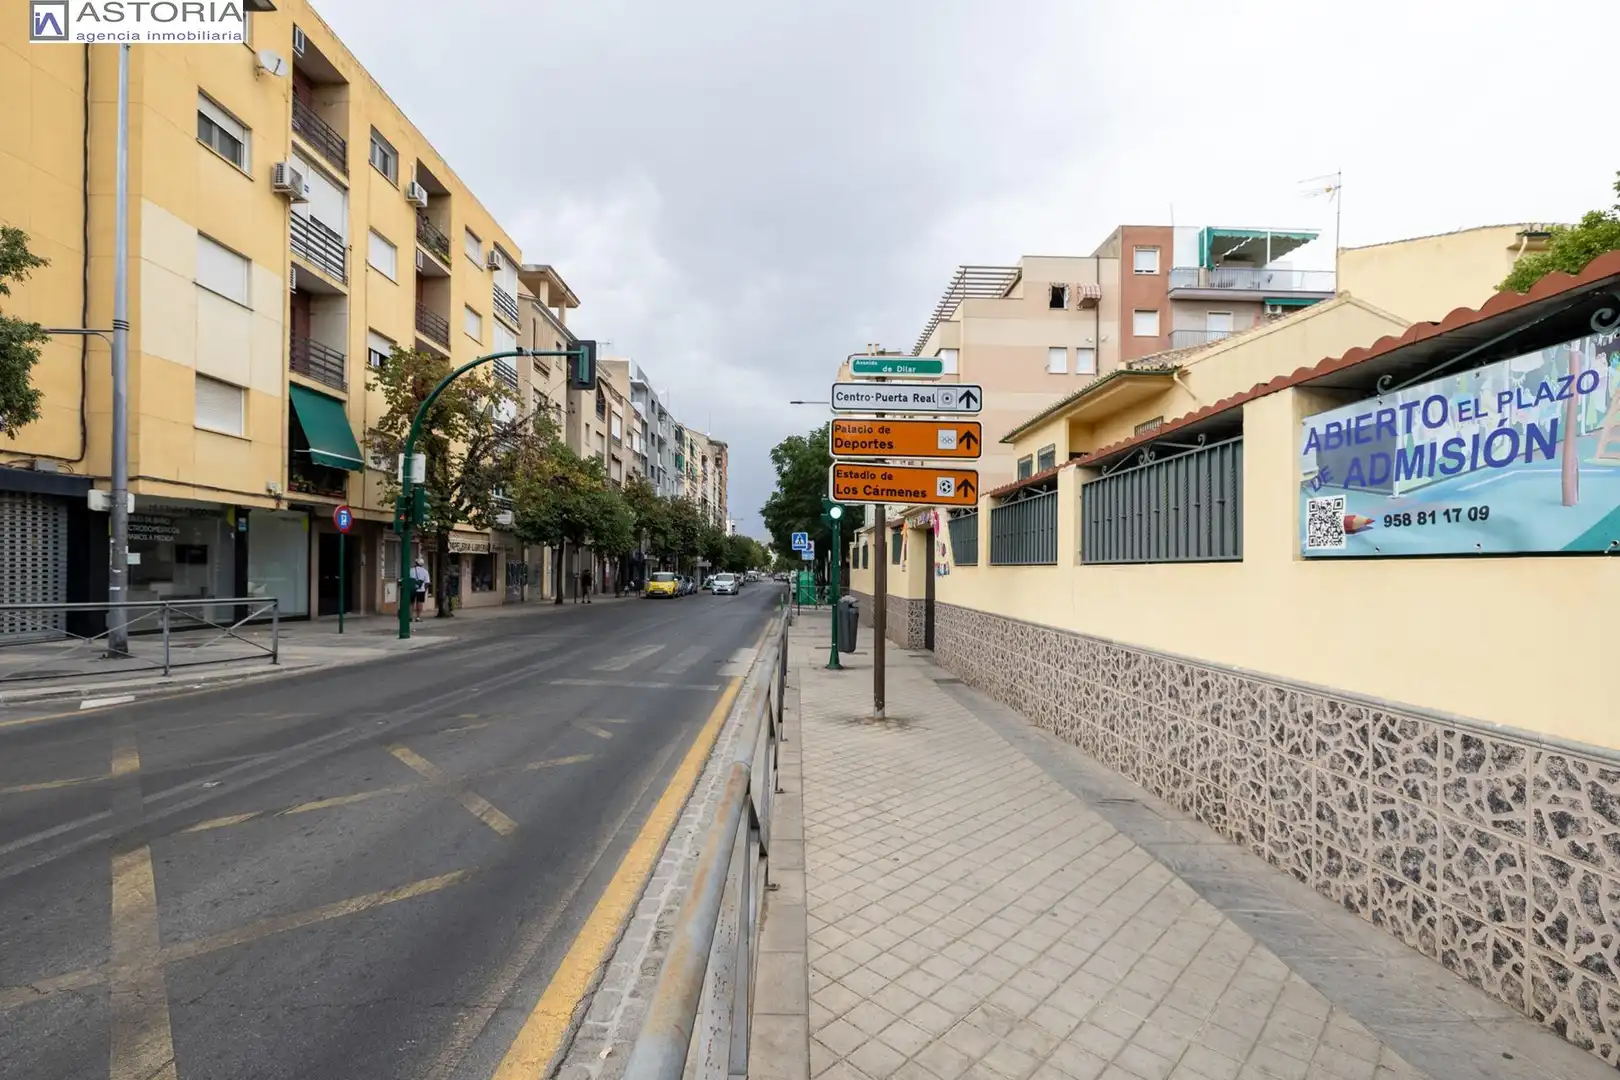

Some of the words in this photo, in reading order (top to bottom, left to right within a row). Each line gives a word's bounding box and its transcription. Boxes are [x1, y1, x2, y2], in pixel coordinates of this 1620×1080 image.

[882, 365, 892, 373] de
[913, 393, 936, 403] Real
[1303, 394, 1449, 456] ABIERTO
[1458, 400, 1488, 422] EL
[1497, 370, 1600, 413] PLAZO
[834, 424, 874, 434] Palacio
[878, 425, 891, 434] de
[834, 438, 894, 450] Deportes
[1311, 465, 1334, 492] DE
[1343, 417, 1559, 490] ADMISIÓN
[836, 469, 876, 480] Estadio
[880, 471, 893, 480] de
[836, 484, 858, 495] Los
[863, 484, 927, 498] Cármenes
[1384, 512, 1412, 528] 958
[1417, 510, 1436, 526] 81
[1443, 507, 1462, 523] 17
[1467, 505, 1490, 522] 09
